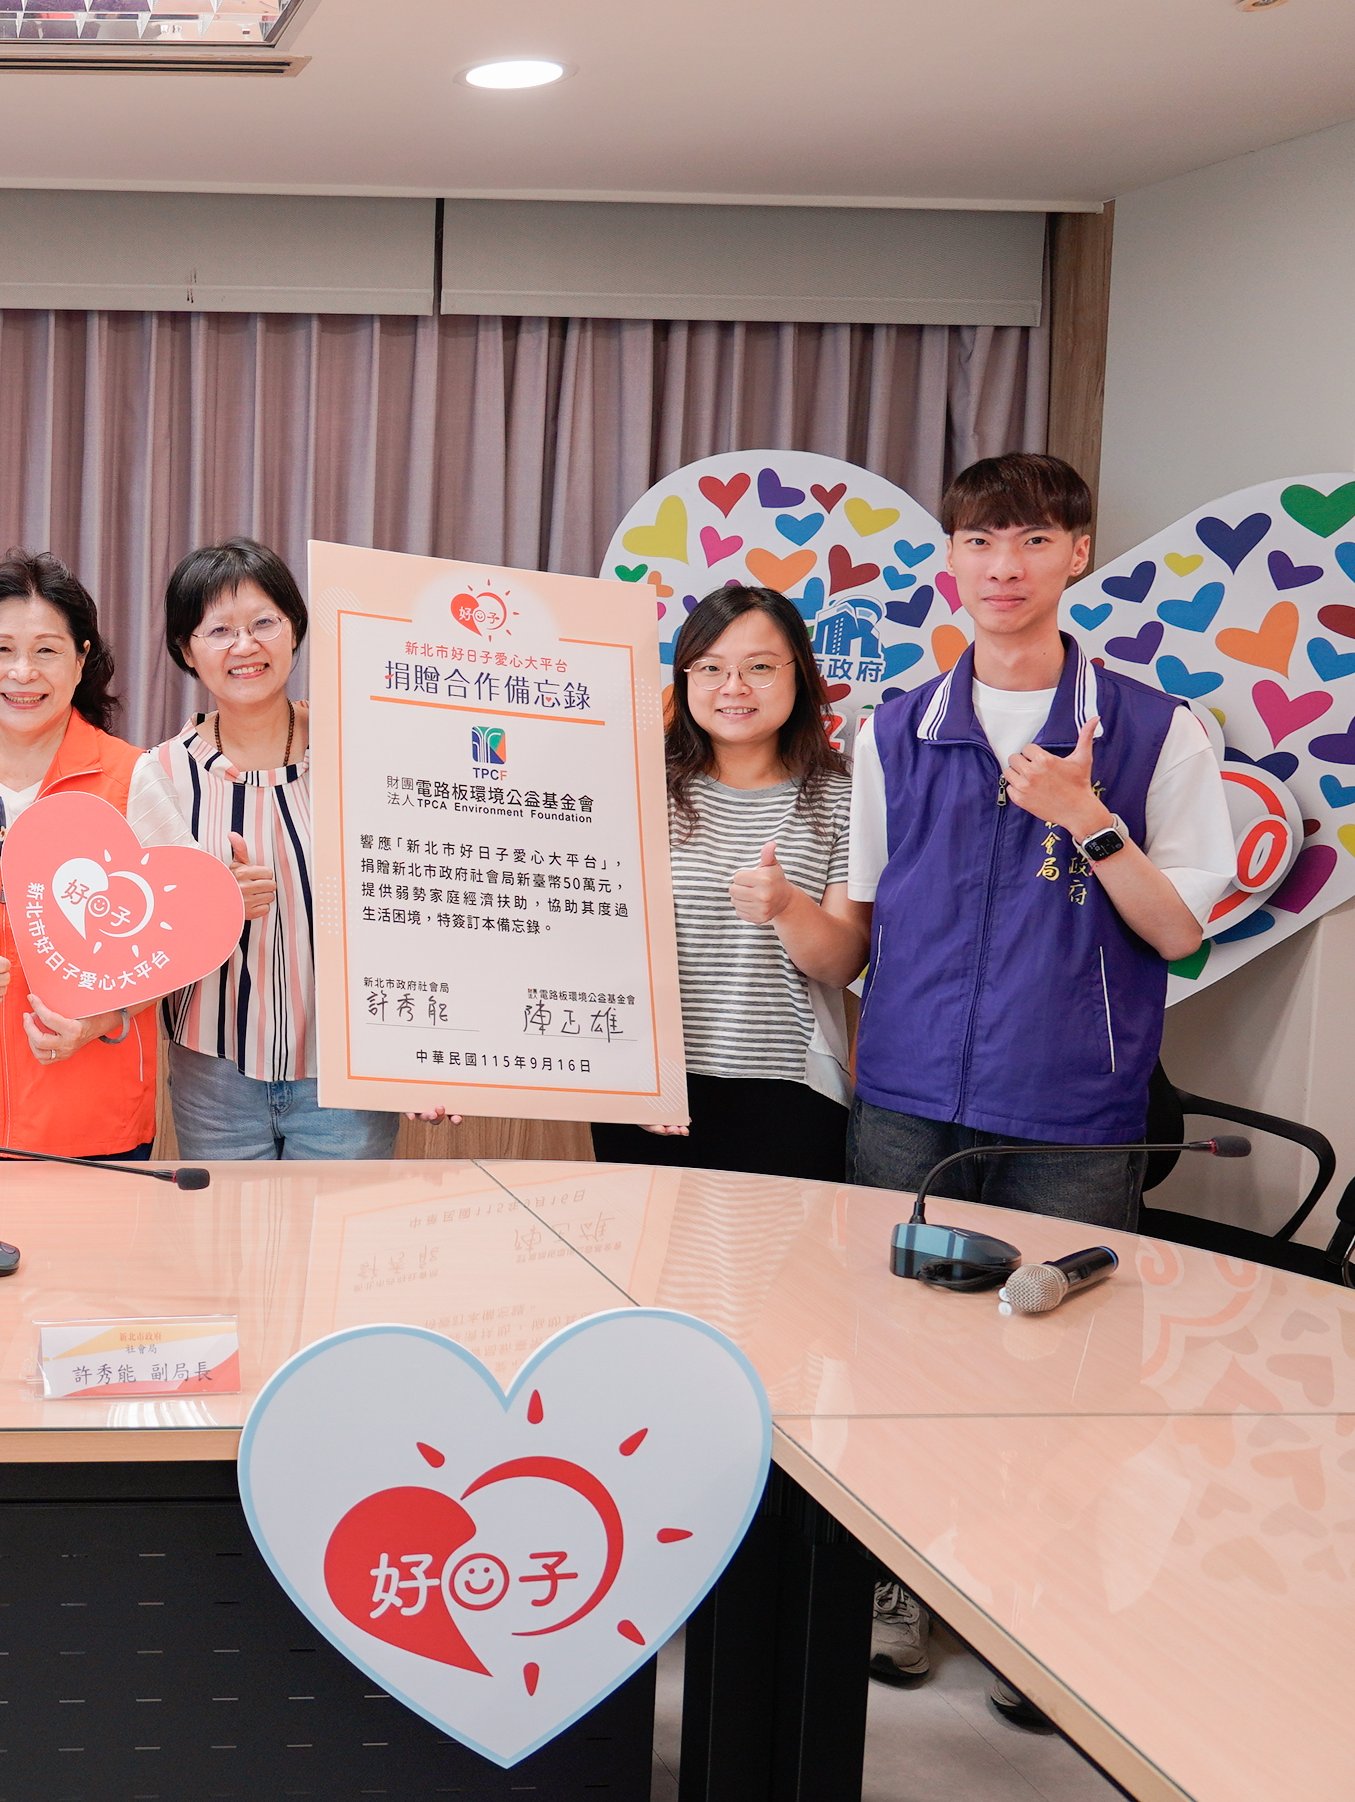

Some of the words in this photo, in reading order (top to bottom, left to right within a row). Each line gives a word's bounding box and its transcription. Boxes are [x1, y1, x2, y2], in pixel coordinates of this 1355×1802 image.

[405, 640, 568, 673] 新北市好日子愛心大平台
[384, 660, 591, 711] 捐贈合作備忘錄
[472, 766, 508, 782] TPCF
[416, 779, 594, 813] 電路板環境公益基金會
[417, 799, 448, 811] TPCA
[454, 802, 524, 818] Environment
[530, 809, 593, 824] Foundation
[26, 881, 171, 992] 新北市好日子愛心大平台
[363, 976, 450, 994] 新北市政府社會局
[416, 1049, 592, 1074] 中華民國115年9月16日
[125, 1343, 158, 1355] 社會局
[72, 1363, 137, 1386] 許秀能
[150, 1361, 213, 1383] 副局長
